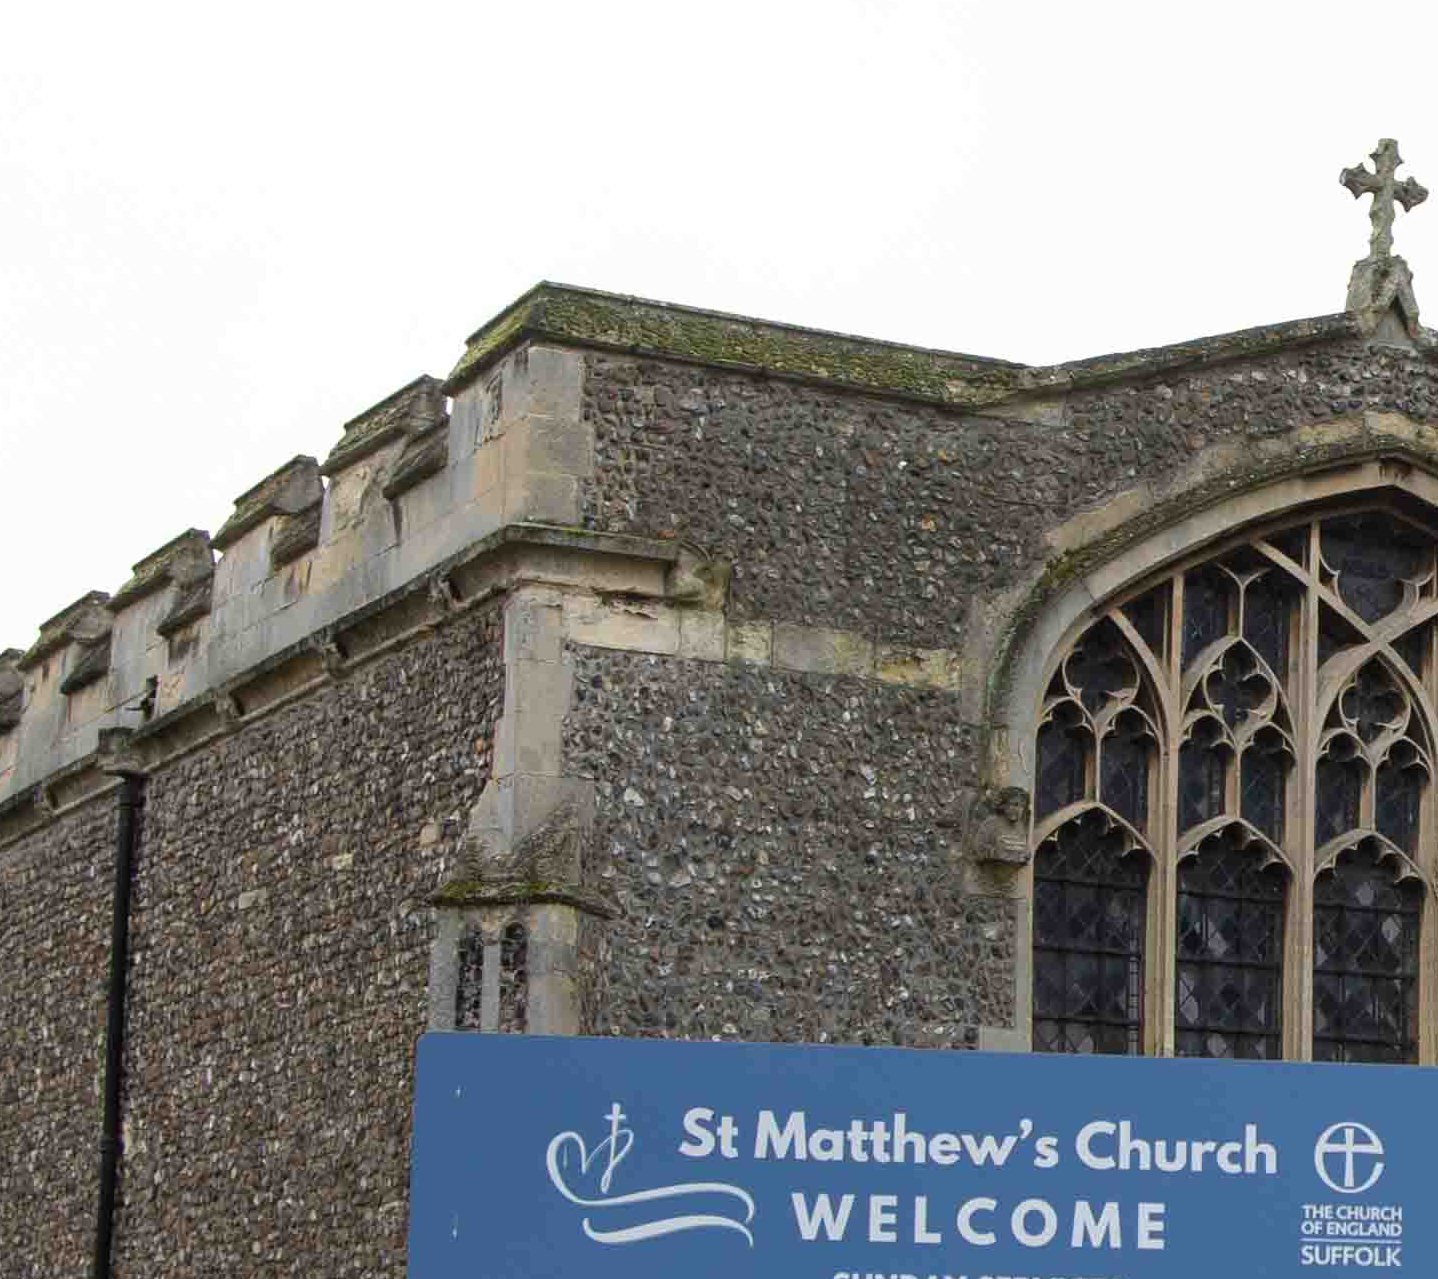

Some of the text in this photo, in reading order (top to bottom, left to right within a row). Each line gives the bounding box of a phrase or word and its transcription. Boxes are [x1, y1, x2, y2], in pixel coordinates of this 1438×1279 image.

[678, 1106, 739, 1159] St
[1074, 1120, 1278, 1174] Church
[791, 1192, 1166, 1251] WELCOME
[1302, 1204, 1403, 1221] THE CHURCH
[1300, 1220, 1403, 1237] OF ENGLAND
[1301, 1244, 1402, 1267] SUFFOLK
